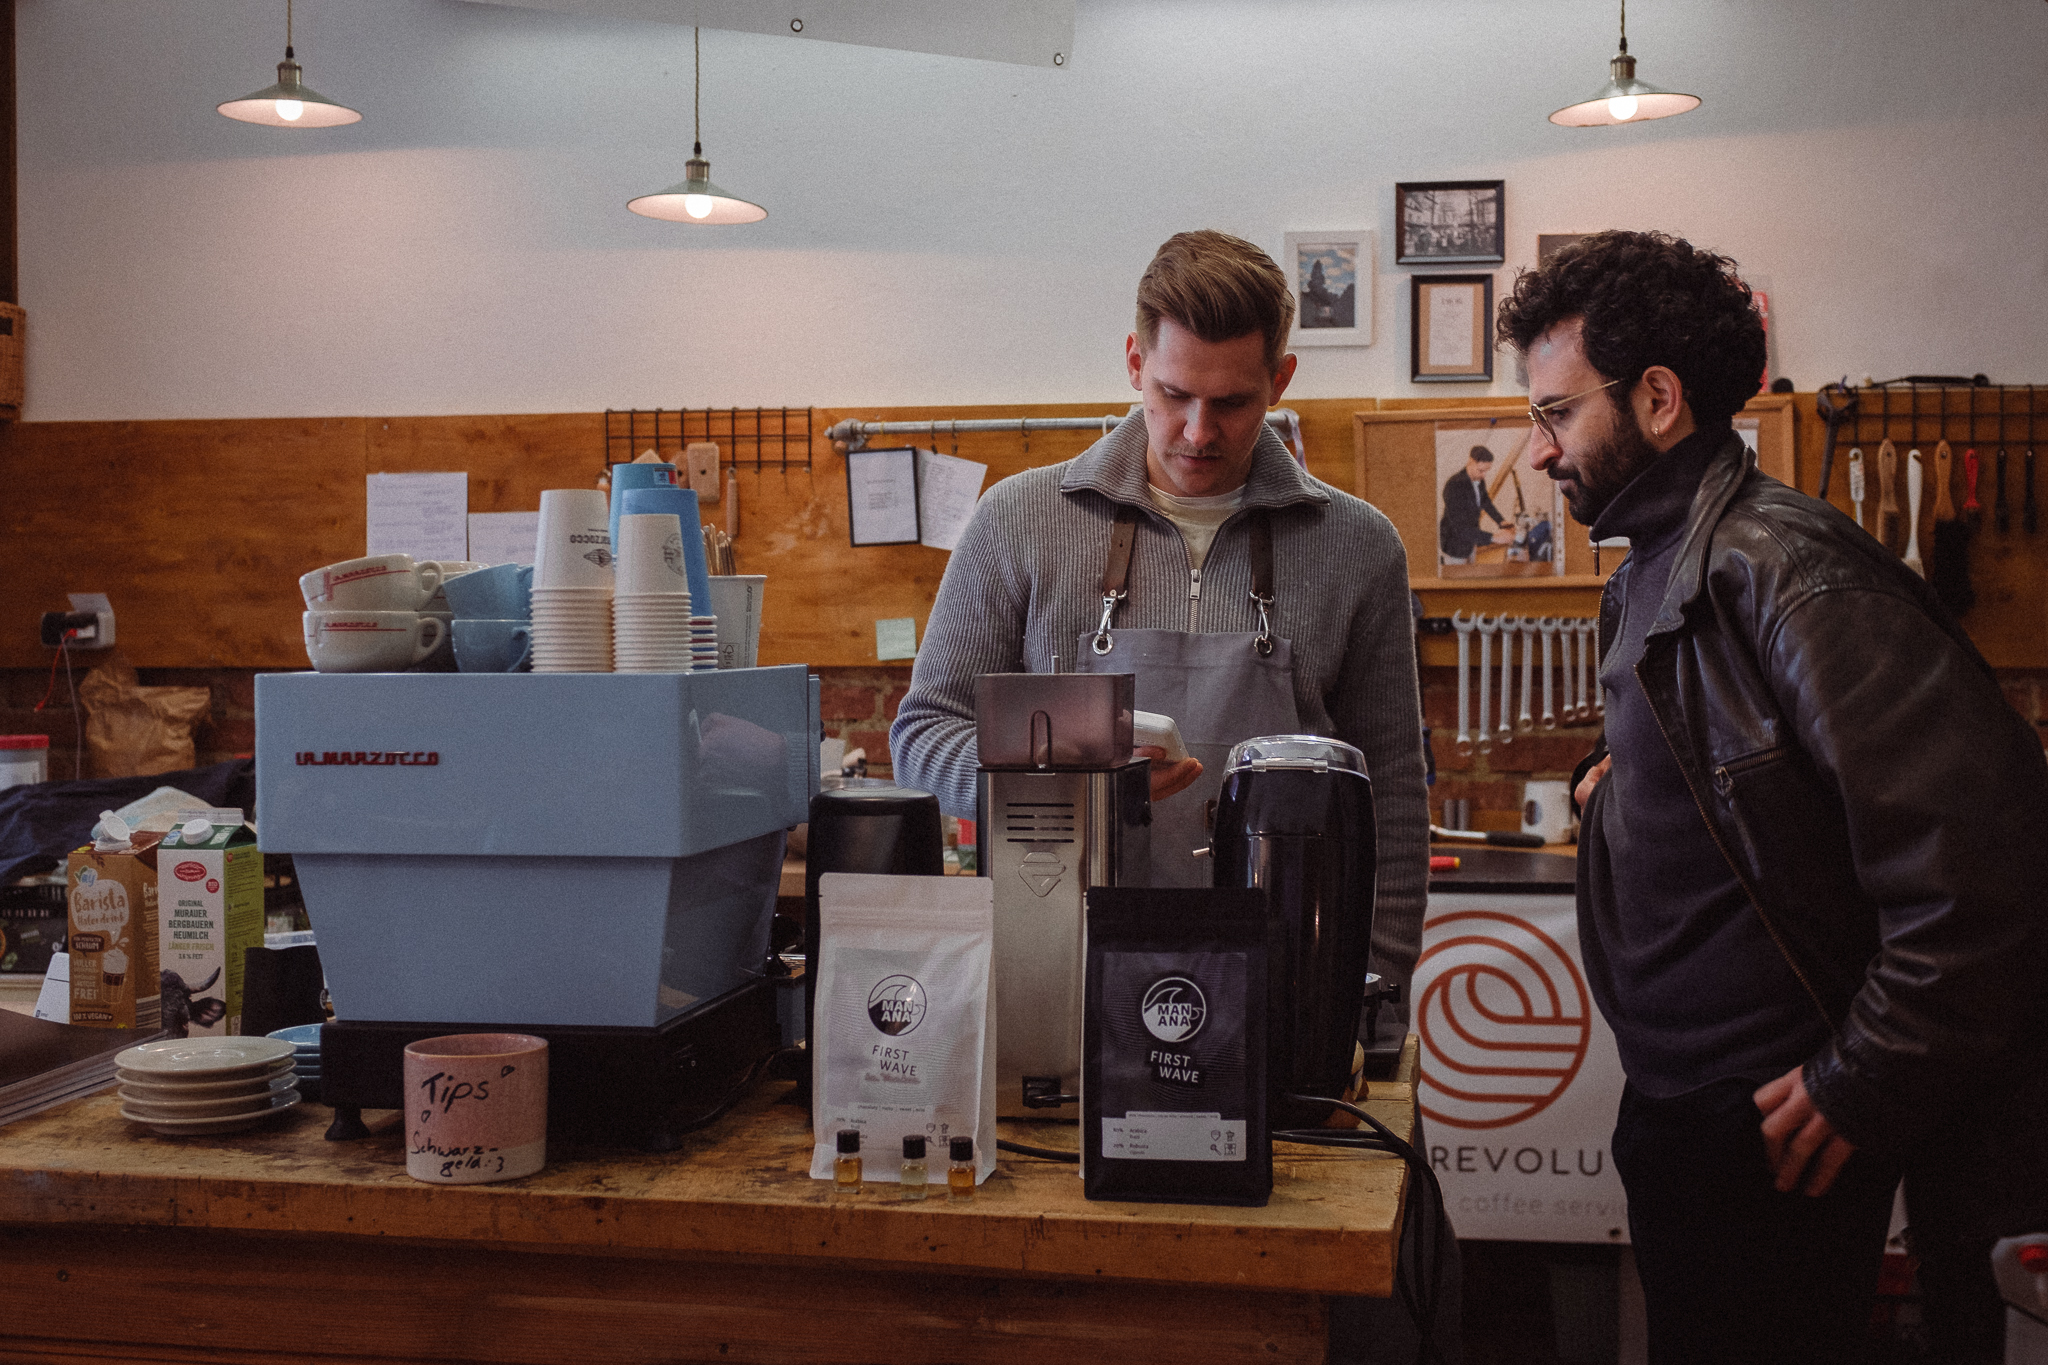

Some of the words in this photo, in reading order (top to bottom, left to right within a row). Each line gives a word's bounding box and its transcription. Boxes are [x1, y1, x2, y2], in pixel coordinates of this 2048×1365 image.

[74, 888, 126, 913] Barista
[178, 899, 203, 907] ORIGINAL
[174, 909, 207, 918] MURAUER
[168, 920, 214, 929] BERGBAUERN
[173, 931, 209, 940] HEUMILCH
[75, 942, 99, 950] SCHAUM
[881, 1000, 914, 1012] MAN
[1157, 1004, 1191, 1016] MAN
[880, 1011, 911, 1022] ANA
[1157, 1016, 1189, 1027] ANA
[872, 1044, 909, 1061] FIRST
[1150, 1050, 1191, 1067] FIRST
[880, 1060, 917, 1076] WAVE
[1160, 1066, 1199, 1083] WAVE
[421, 1072, 489, 1114] Tips
[1459, 1193, 1543, 1215] coffee
